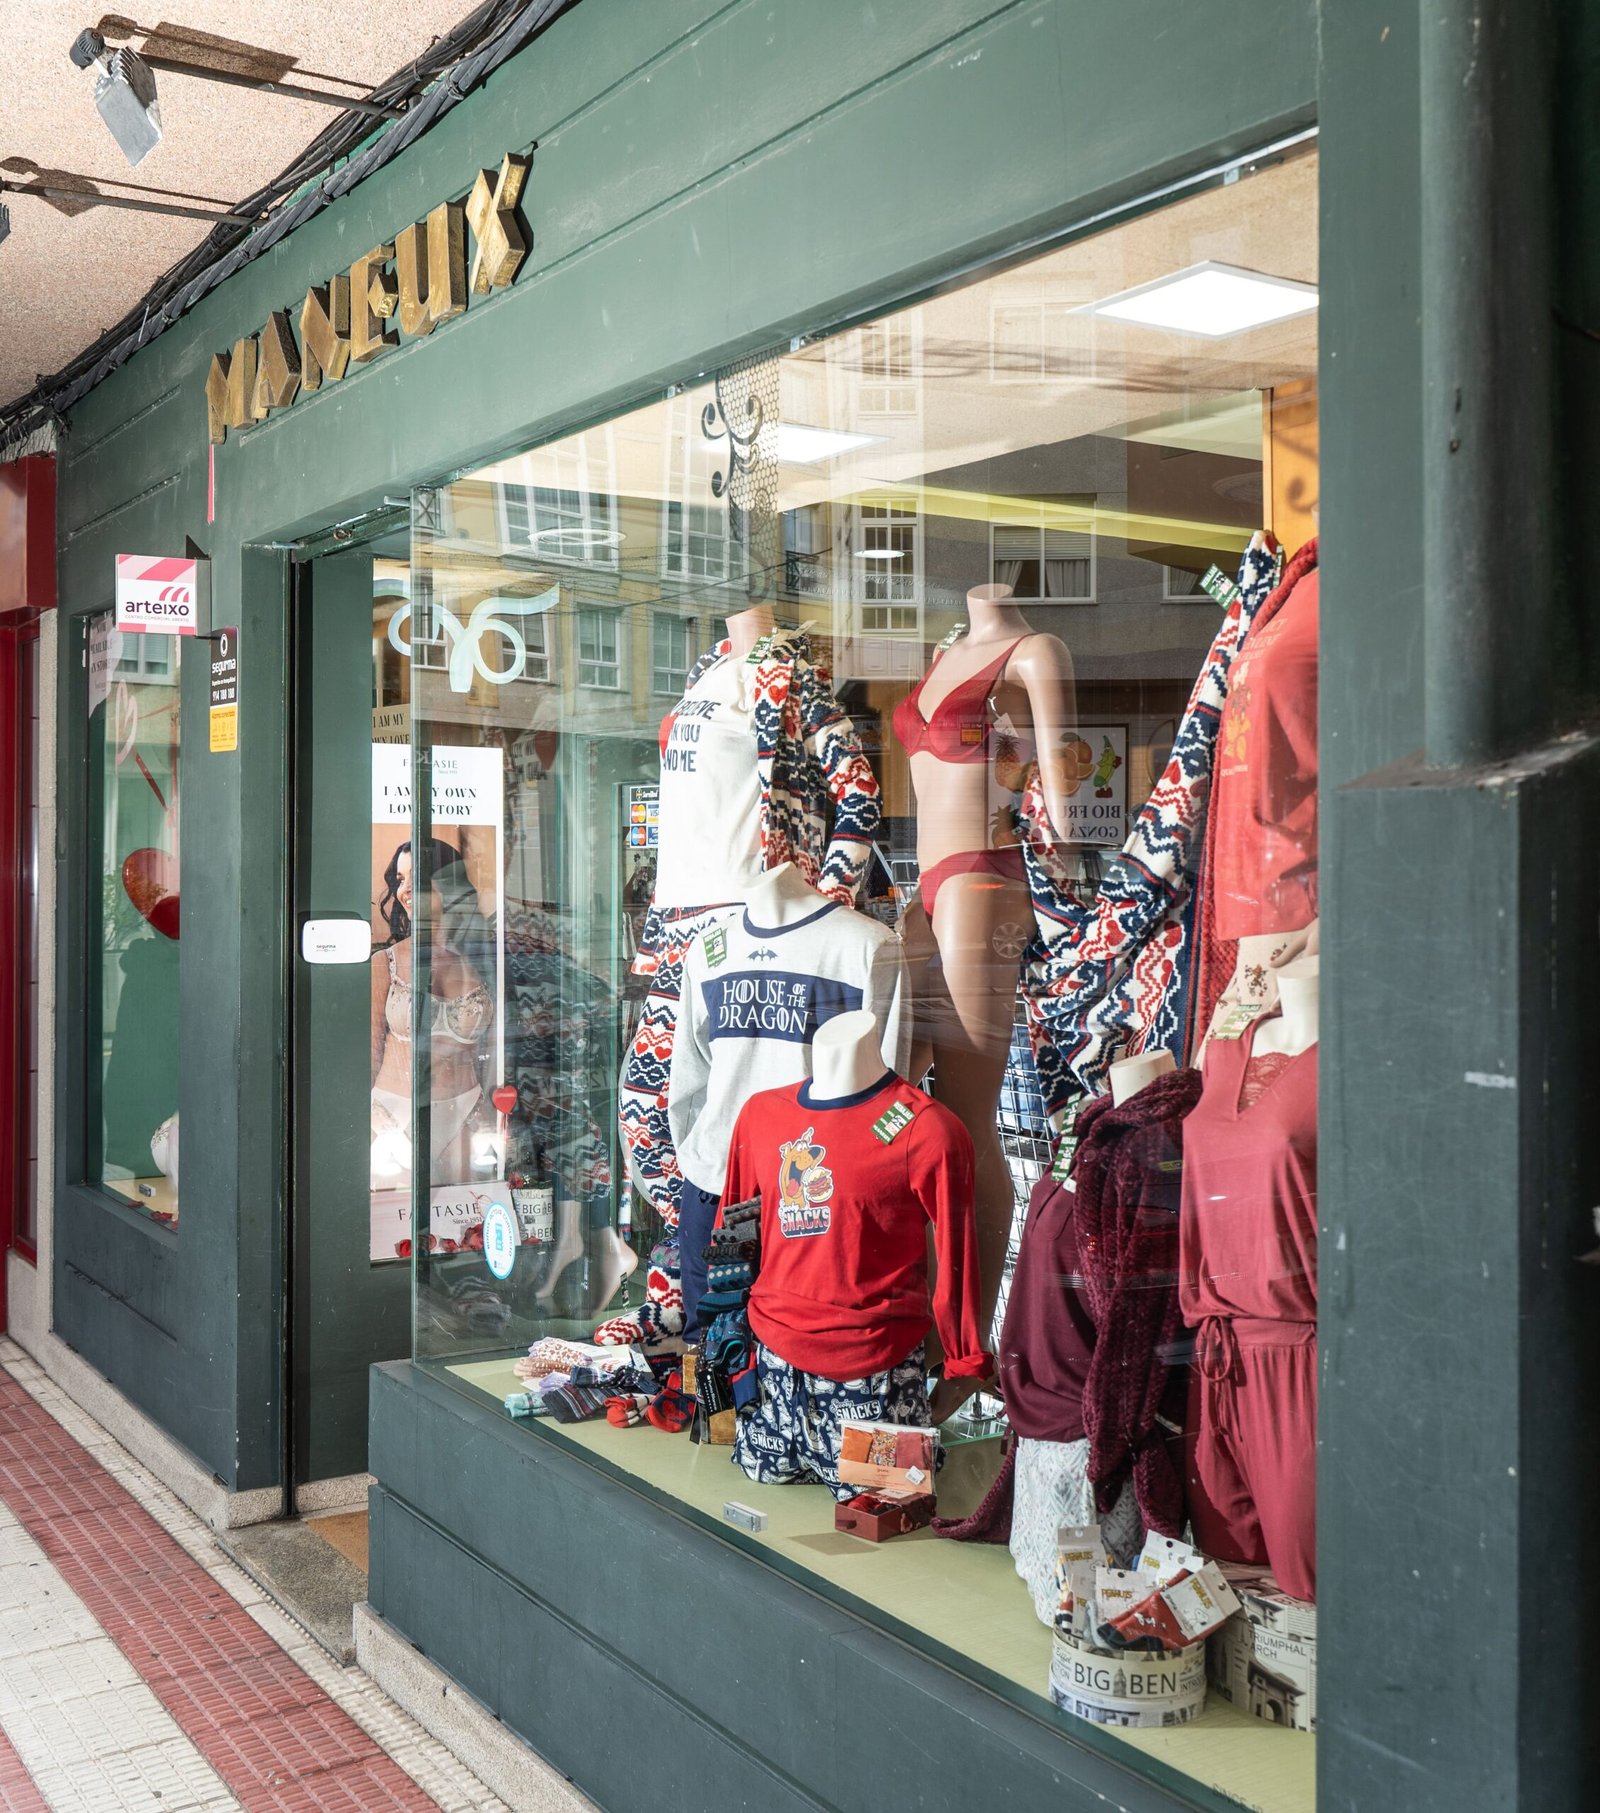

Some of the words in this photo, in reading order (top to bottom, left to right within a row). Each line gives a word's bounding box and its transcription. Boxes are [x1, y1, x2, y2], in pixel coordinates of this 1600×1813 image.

[205, 152, 526, 445] MANEUX
[125, 601, 190, 616] arteixo
[212, 658, 236, 676] segurma
[378, 714, 390, 728] AM
[393, 713, 405, 726] MY
[680, 723, 701, 743] YOU
[680, 750, 697, 772] ME
[384, 786, 388, 796] I
[445, 787, 477, 798] OWN
[722, 979, 786, 1006] HOUSE
[792, 983, 806, 995] OF
[787, 994, 806, 1008] THE
[718, 1004, 809, 1035] DRAGON
[522, 1203, 541, 1214] BIG
[782, 1207, 831, 1232] SNACKS
[836, 1400, 881, 1420] SNACKS
[751, 1433, 785, 1453] SNACKS
[1101, 1588, 1133, 1599] PEANUTS
[1250, 1630, 1307, 1656] TRIUMPHAL
[1250, 1642, 1278, 1659] ARCH
[1074, 1662, 1111, 1691] BIG
[1130, 1671, 1177, 1695] BEN
